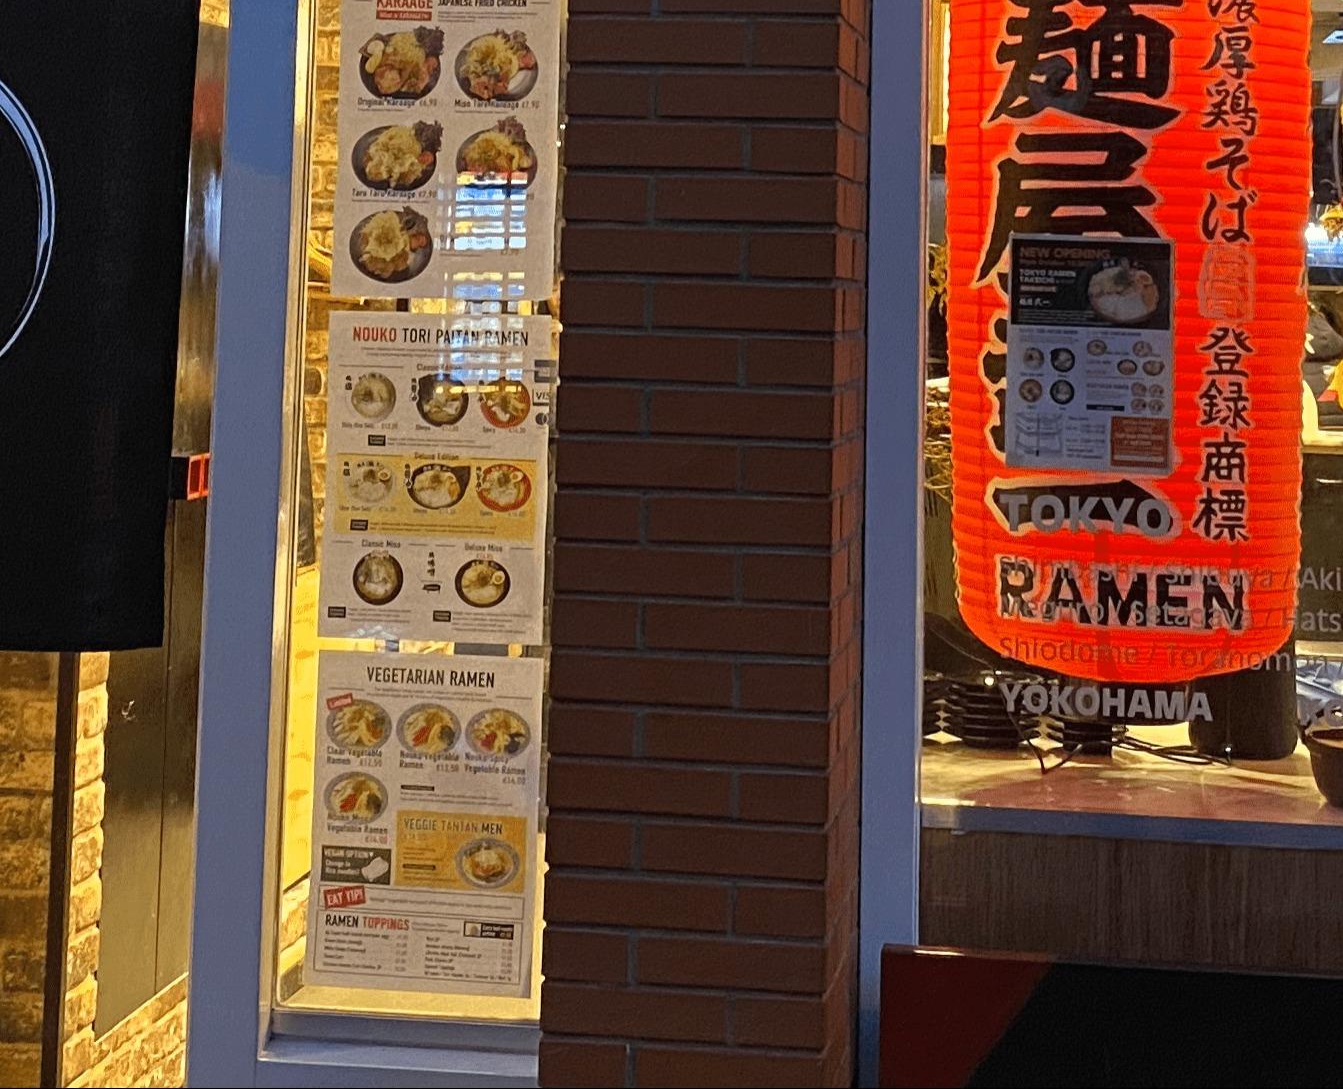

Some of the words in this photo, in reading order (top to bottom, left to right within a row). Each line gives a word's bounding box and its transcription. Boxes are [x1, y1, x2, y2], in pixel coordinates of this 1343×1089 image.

[1019, 247, 1050, 258] NEW
[1052, 247, 1111, 259] OPENING
[352, 327, 397, 342] NOUKO
[403, 328, 431, 343] TORI
[1193, 325, 1255, 543] 登録商標
[998, 493, 1172, 537] TOKYO
[999, 560, 1244, 632] RAMEN
[1000, 591, 1104, 623] Meguro
[999, 636, 1144, 666] Shiodome
[367, 666, 445, 685] VEGETARIAN
[449, 670, 495, 688] RAMEN
[999, 682, 1214, 722] YOKOHAMA
[403, 817, 437, 831] VEGGIE
[440, 820, 478, 833] TANTAN
[480, 823, 503, 835] MEN
[325, 914, 359, 928] RAMEN
[362, 916, 410, 931] TOPPINGS
